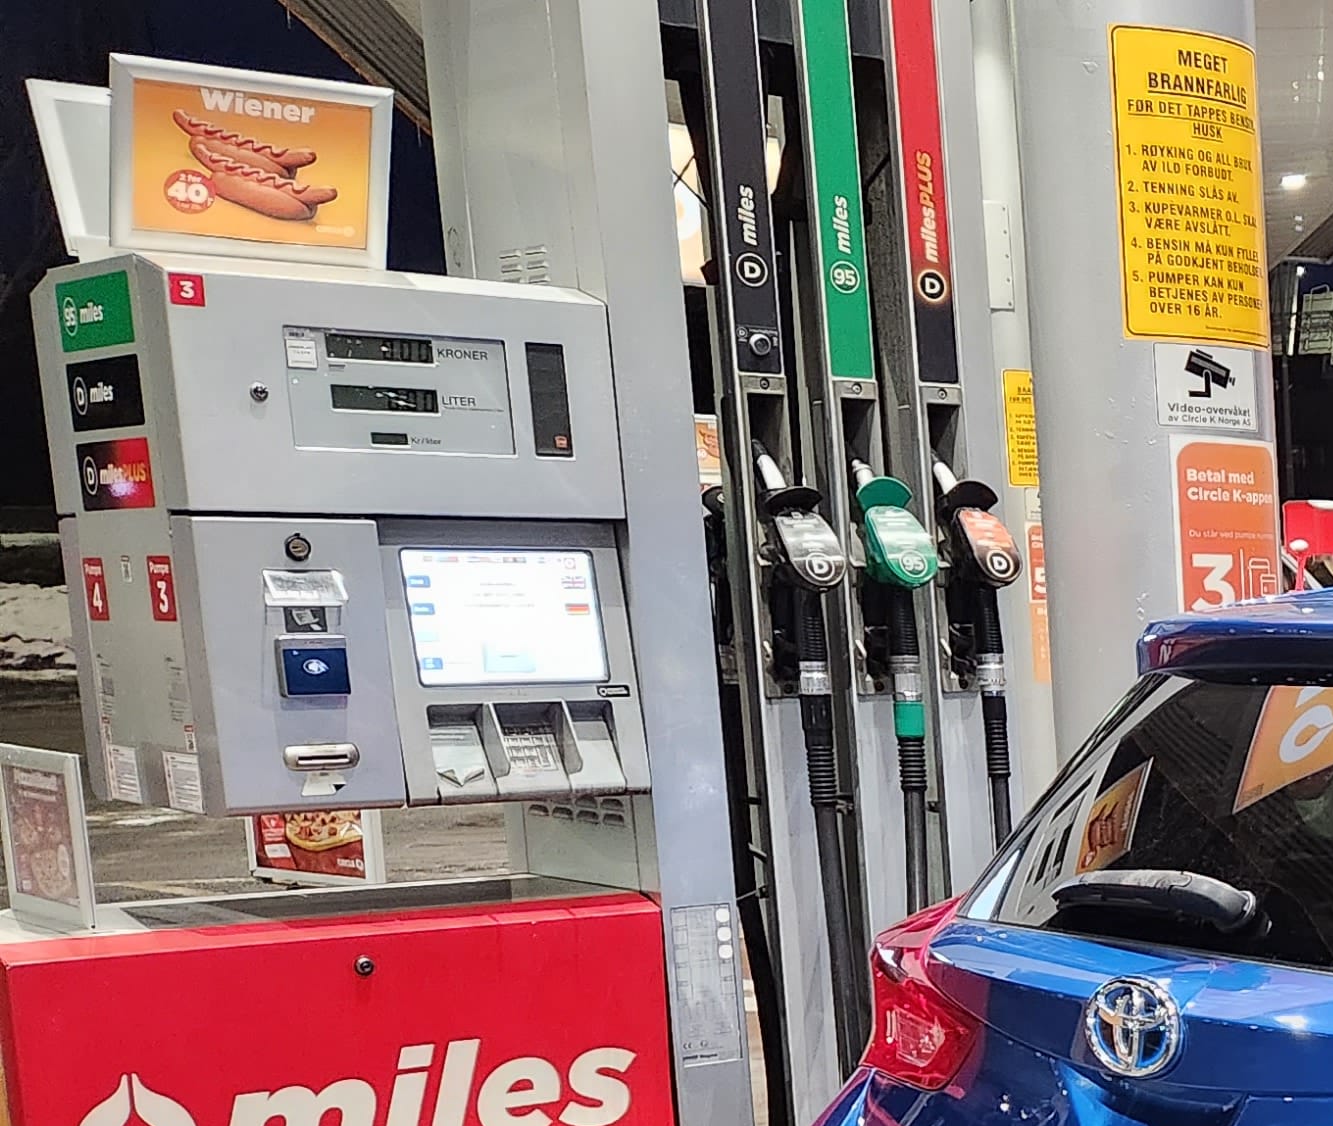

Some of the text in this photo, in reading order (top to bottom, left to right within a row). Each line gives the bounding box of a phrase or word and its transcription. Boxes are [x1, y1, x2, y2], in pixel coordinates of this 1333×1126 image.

[1177, 49, 1228, 74] MEGET
[1148, 71, 1247, 105] BRANNFARLIG
[200, 86, 316, 124] Wiener
[1128, 98, 1153, 113] FØR
[1159, 101, 1182, 116] DET
[1187, 104, 1227, 123] TAPPES
[1193, 123, 1223, 139] HUSK
[1125, 144, 1137, 156] 1.
[1141, 144, 1194, 161] RØYKING
[1197, 150, 1212, 163] OG
[1215, 153, 1231, 167] ALL
[1142, 160, 1157, 172] AV
[1162, 161, 1181, 174] ILD
[1143, 181, 1195, 197] TENNING
[1199, 184, 1224, 201] SLÅS
[738, 185, 758, 246] miles
[1145, 217, 1181, 231] VÆRE
[831, 196, 852, 255] miles
[1146, 238, 1190, 252] BENSIN
[1194, 240, 1213, 255] MÅ
[1216, 244, 1234, 257] KUN
[743, 262, 761, 279] D
[1147, 252, 1162, 266] PÅ
[1167, 255, 1224, 271] GODKJENT
[834, 269, 857, 287] 95
[924, 278, 941, 294] D
[1148, 271, 1200, 286] PUMPER
[1203, 275, 1224, 289] KAN
[1227, 278, 1245, 292] KUN
[180, 280, 195, 298] 3
[1149, 286, 1209, 302] BETJENES
[1212, 292, 1225, 304] AV
[79, 302, 104, 324] miles
[1149, 301, 1182, 315] OVER
[1187, 304, 1201, 317] 16
[436, 348, 488, 361] KRONER
[89, 381, 114, 403] miles
[441, 396, 476, 407] LITER
[1168, 402, 1251, 417] Video-overvåket
[1181, 414, 1208, 424] Circle
[1209, 416, 1216, 424] K
[1186, 468, 1255, 485] Betal med
[1187, 486, 1230, 502] Circle
[813, 556, 829, 575] D
[901, 556, 926, 572] 95
[993, 556, 1007, 570] D
[1191, 553, 1237, 612] 3
[92, 581, 103, 614] 4
[156, 580, 169, 614] 3
